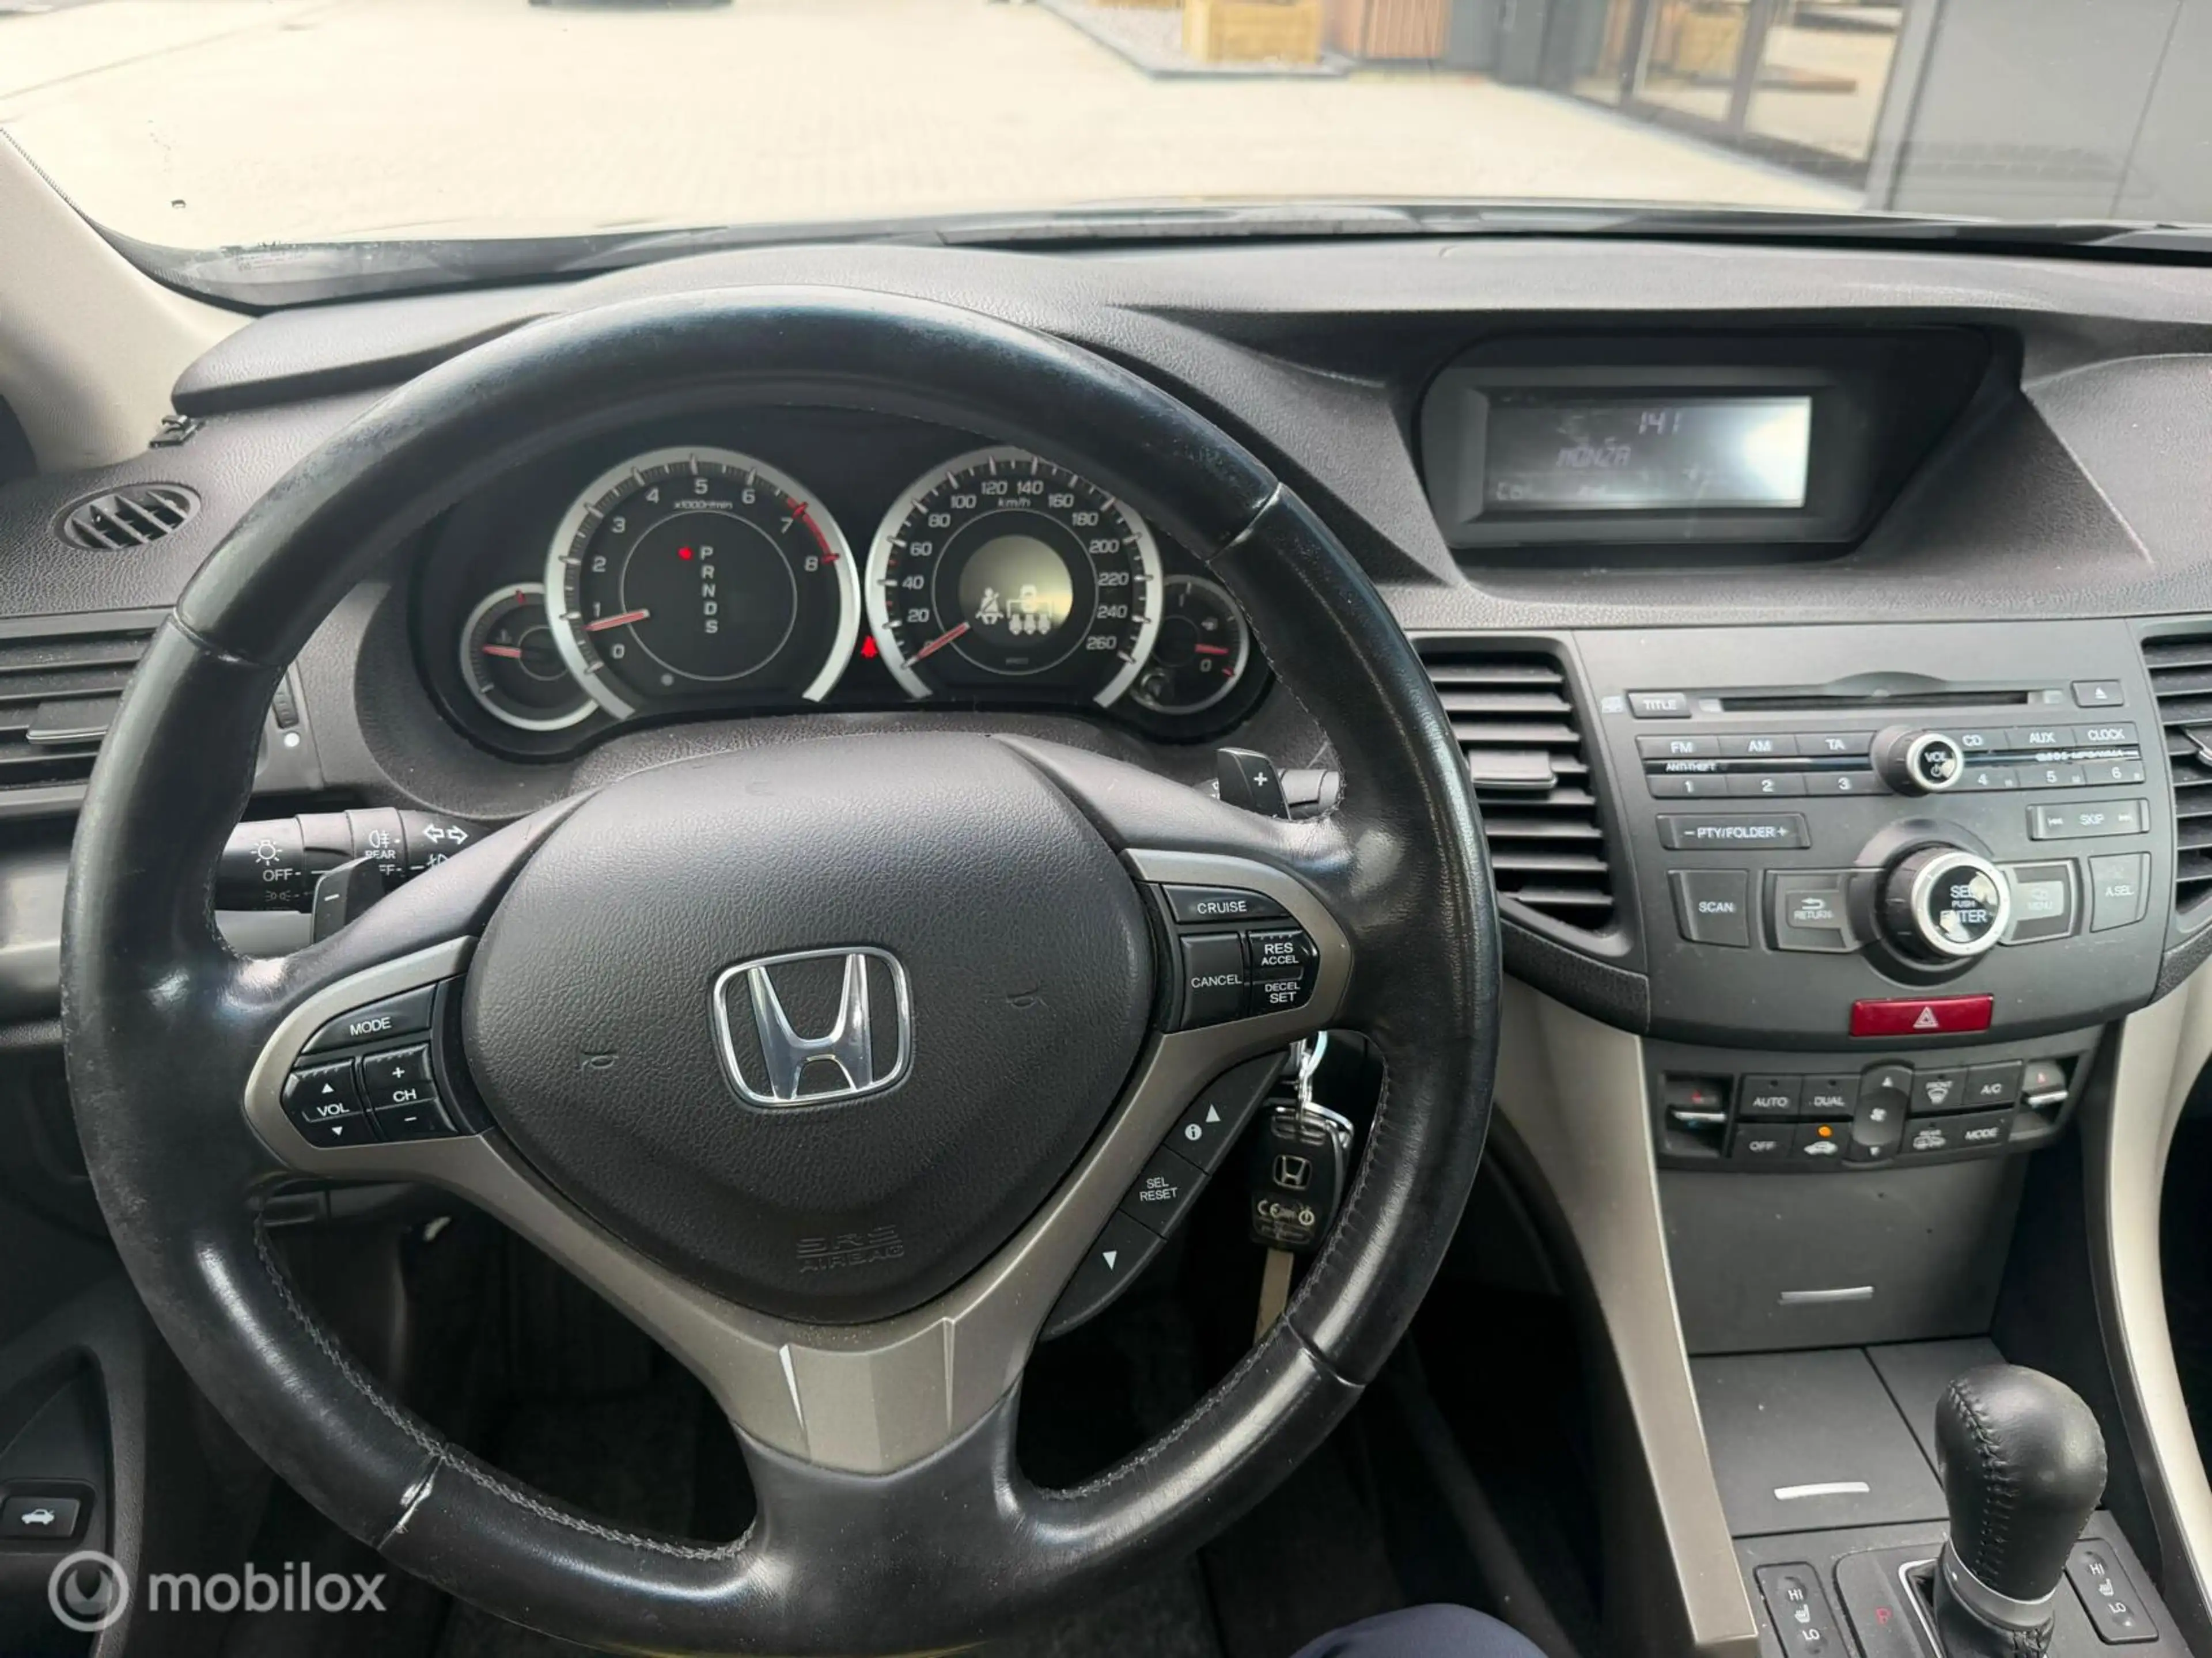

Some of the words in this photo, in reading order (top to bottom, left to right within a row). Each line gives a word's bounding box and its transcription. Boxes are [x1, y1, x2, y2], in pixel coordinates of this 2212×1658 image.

[695, 479, 708, 494] 5
[982, 482, 1007, 495] 120
[1017, 481, 1043, 495] 140
[646, 490, 660, 503] 4
[742, 490, 755, 504] 6
[950, 495, 976, 509] 100
[997, 497, 1031, 509] km/h
[1048, 495, 1075, 508] 160
[612, 518, 626, 533] 3
[781, 518, 794, 533] 7
[929, 514, 950, 528] 80
[1072, 513, 1098, 526] 180
[910, 542, 931, 556] 60
[1089, 540, 1119, 553] 200
[700, 547, 713, 560] P
[593, 557, 606, 572] 2
[805, 557, 818, 572] 8
[702, 566, 714, 579] R
[1098, 572, 1129, 586] 220
[902, 576, 923, 590] 40
[702, 584, 715, 598] N
[593, 602, 601, 617] 1
[704, 602, 717, 616] D
[1097, 605, 1128, 619] 240
[908, 609, 929, 623] 20
[705, 620, 718, 634] S
[1087, 636, 1116, 650] 260
[612, 644, 624, 659] 0
[1643, 699, 1677, 711] TITLE
[1962, 734, 1983, 746] CD
[2029, 732, 2056, 743] AUX
[2088, 728, 2126, 741] CLOCK
[1671, 742, 1694, 753] FM
[1748, 741, 1771, 752] AM
[1825, 738, 1845, 750] TA
[1925, 751, 1946, 762] VOL
[1978, 773, 1988, 786] 4
[2046, 771, 2057, 783] 5
[2112, 767, 2123, 779] 6
[1685, 781, 1694, 793] 1
[1762, 779, 1775, 792] 2
[1838, 777, 1851, 790] 3
[2080, 814, 2104, 826] SKIP
[263, 868, 293, 882] OFF
[1197, 900, 1248, 915] CRUISE
[1698, 901, 1735, 913] SCAN
[1793, 909, 1834, 920] RETURN
[1264, 943, 1294, 955] RES
[1260, 955, 1300, 966] ACCEL
[1190, 974, 1243, 989] CANCEL
[1264, 981, 1301, 993] DECEL
[1269, 992, 1297, 1004] SET
[350, 1017, 392, 1036] MODE
[393, 1088, 418, 1103] CH
[1980, 1083, 2002, 1095] A/C
[1752, 1096, 1789, 1108] AUTO
[1814, 1095, 1846, 1107] DUAL
[316, 1102, 351, 1117] VOL
[1964, 1126, 1999, 1141] MODE
[1749, 1140, 1777, 1152] OFF
[1146, 1177, 1169, 1189] SEL
[1139, 1186, 1178, 1202] RESET
[2090, 1562, 2105, 1576] HI
[1788, 1588, 1804, 1602] HI
[2107, 1602, 2127, 1614] LO
[1802, 1628, 1821, 1641] LO
